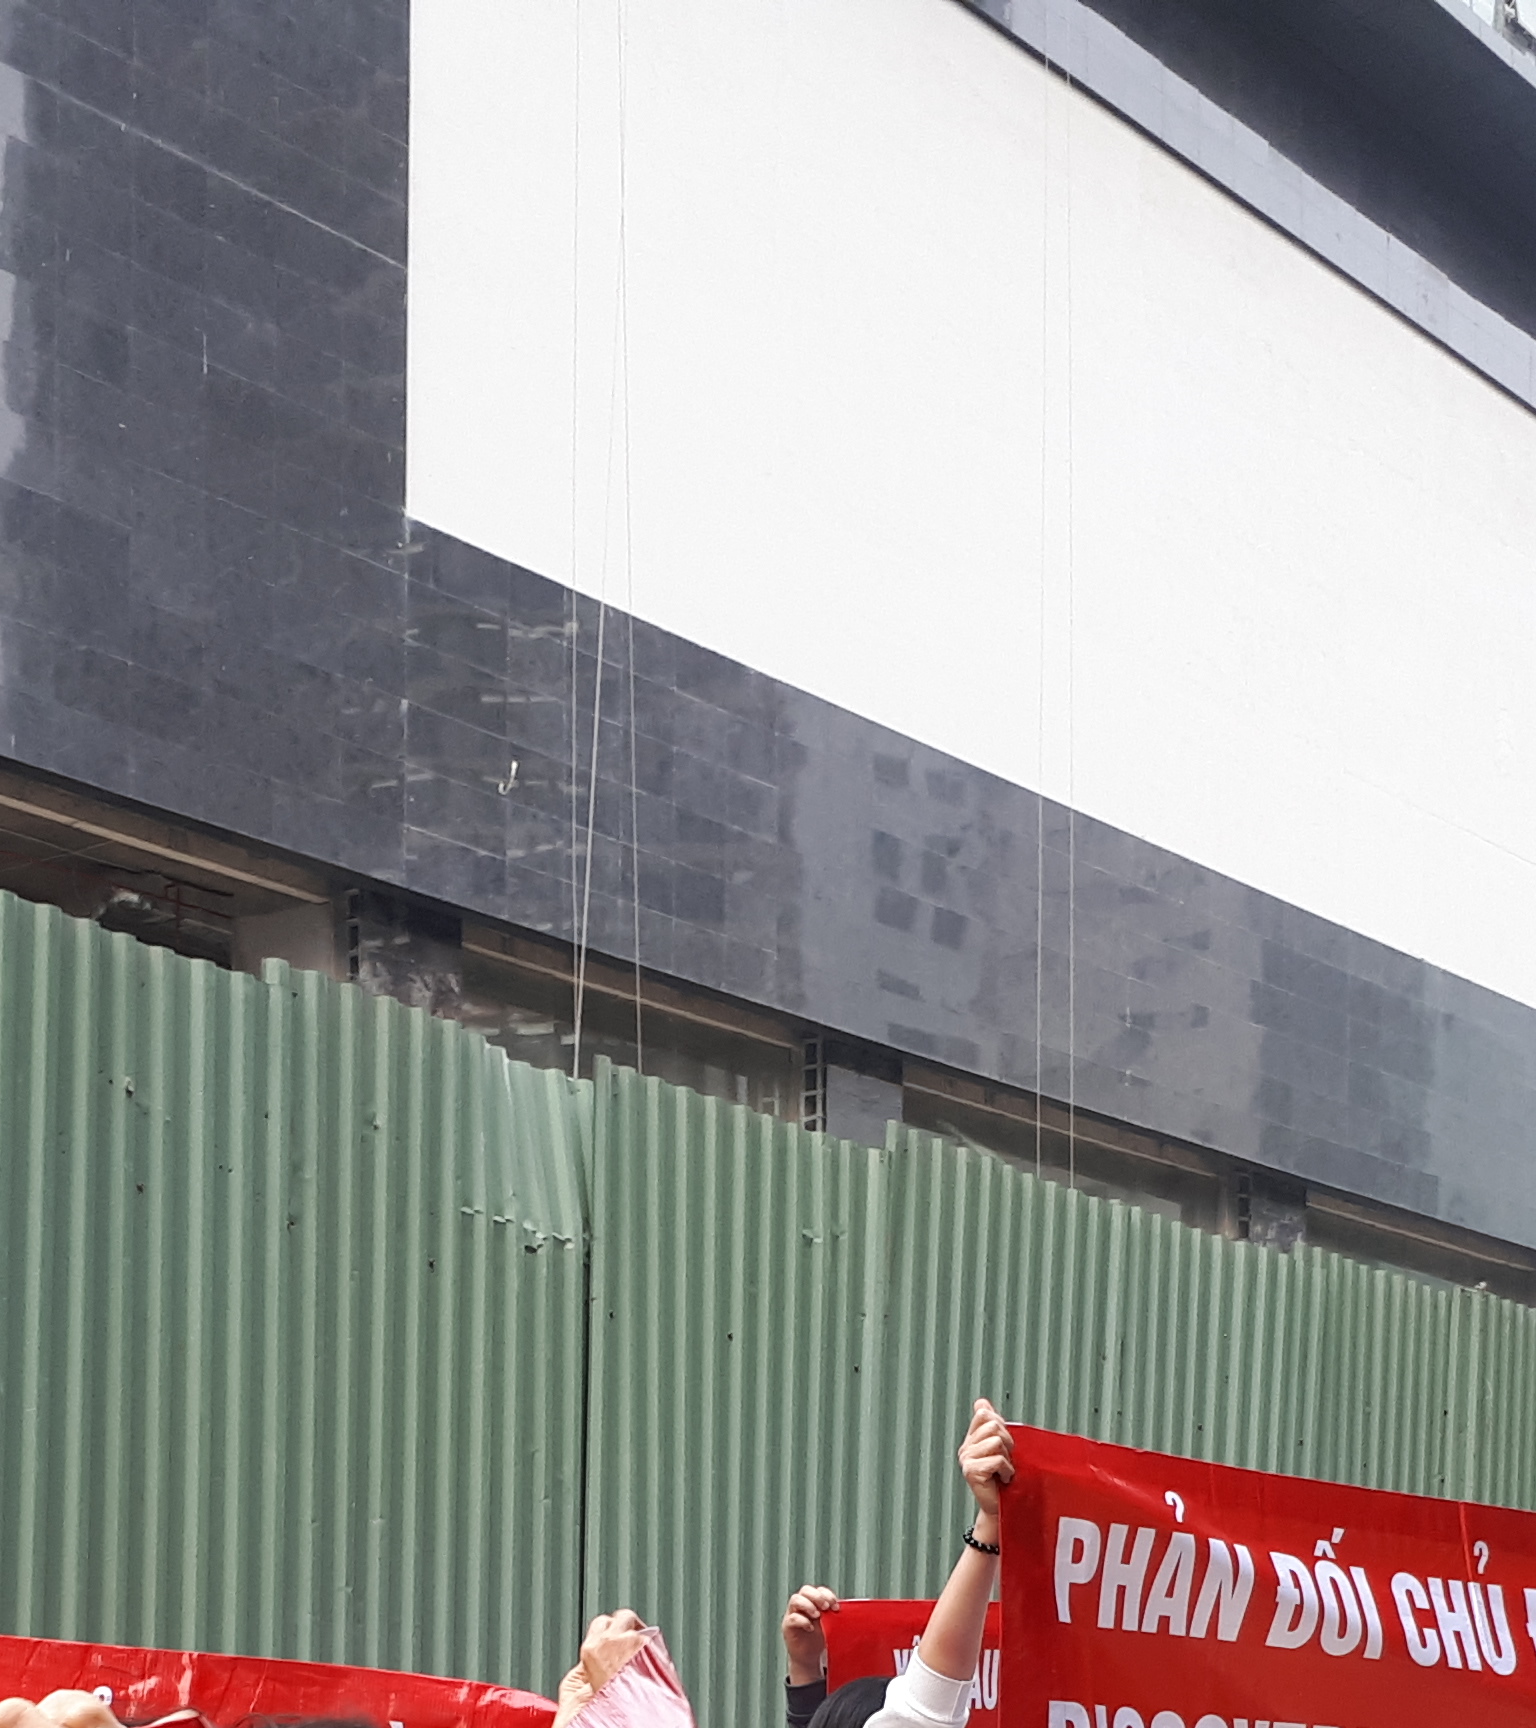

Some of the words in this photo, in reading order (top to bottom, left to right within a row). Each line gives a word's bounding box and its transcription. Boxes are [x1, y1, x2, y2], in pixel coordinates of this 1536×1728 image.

[1054, 1490, 1255, 1643] PHẢN
[1265, 1527, 1384, 1661] ĐỐI
[1390, 1540, 1516, 1677] CHỦ
